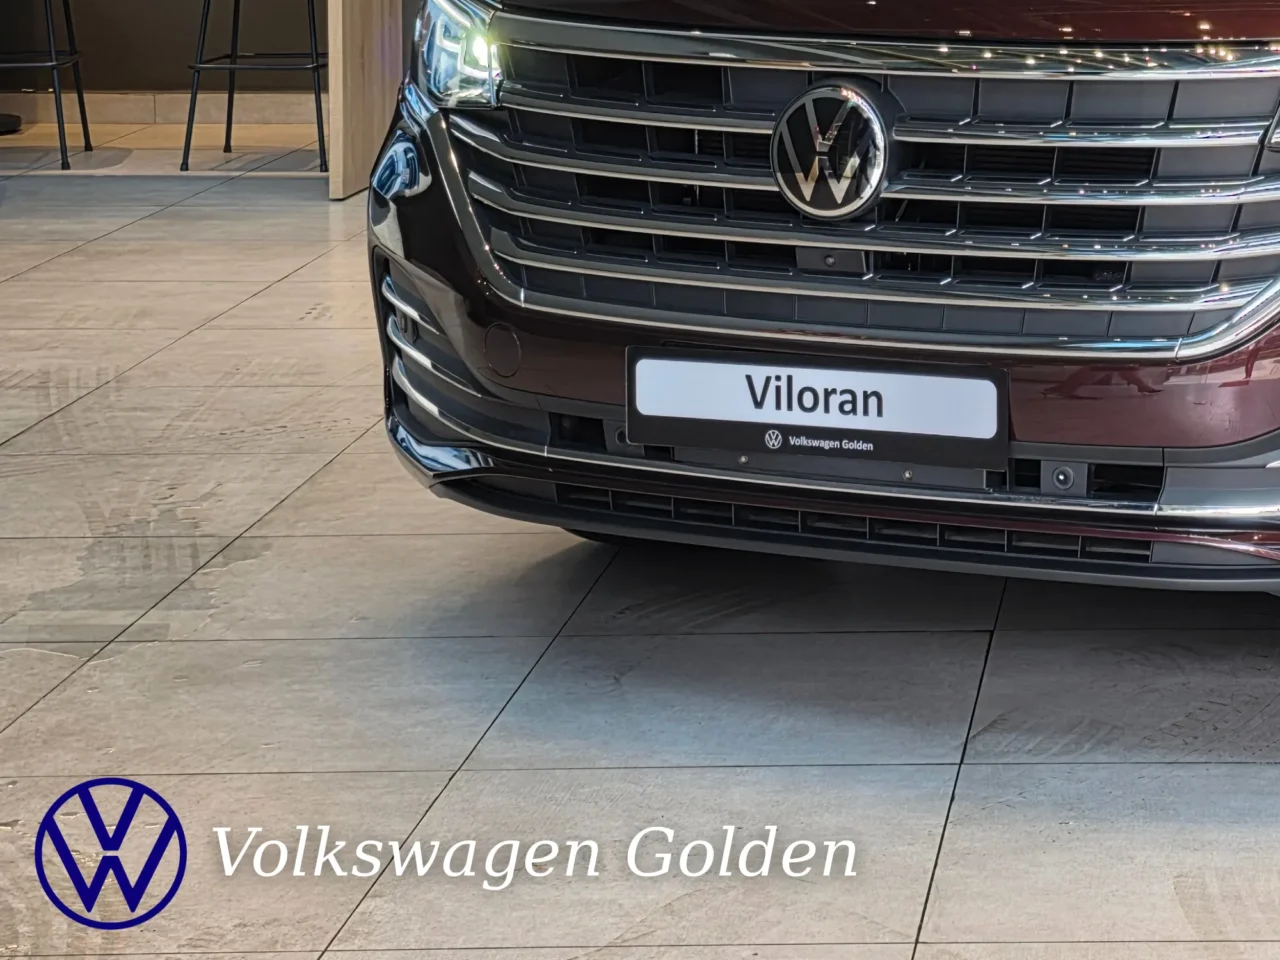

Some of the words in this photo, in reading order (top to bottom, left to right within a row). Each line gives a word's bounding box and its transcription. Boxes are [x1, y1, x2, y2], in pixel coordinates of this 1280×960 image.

[745, 373, 885, 418] Viloran
[789, 436, 840, 450] Volkswagen
[842, 440, 874, 451] Golden
